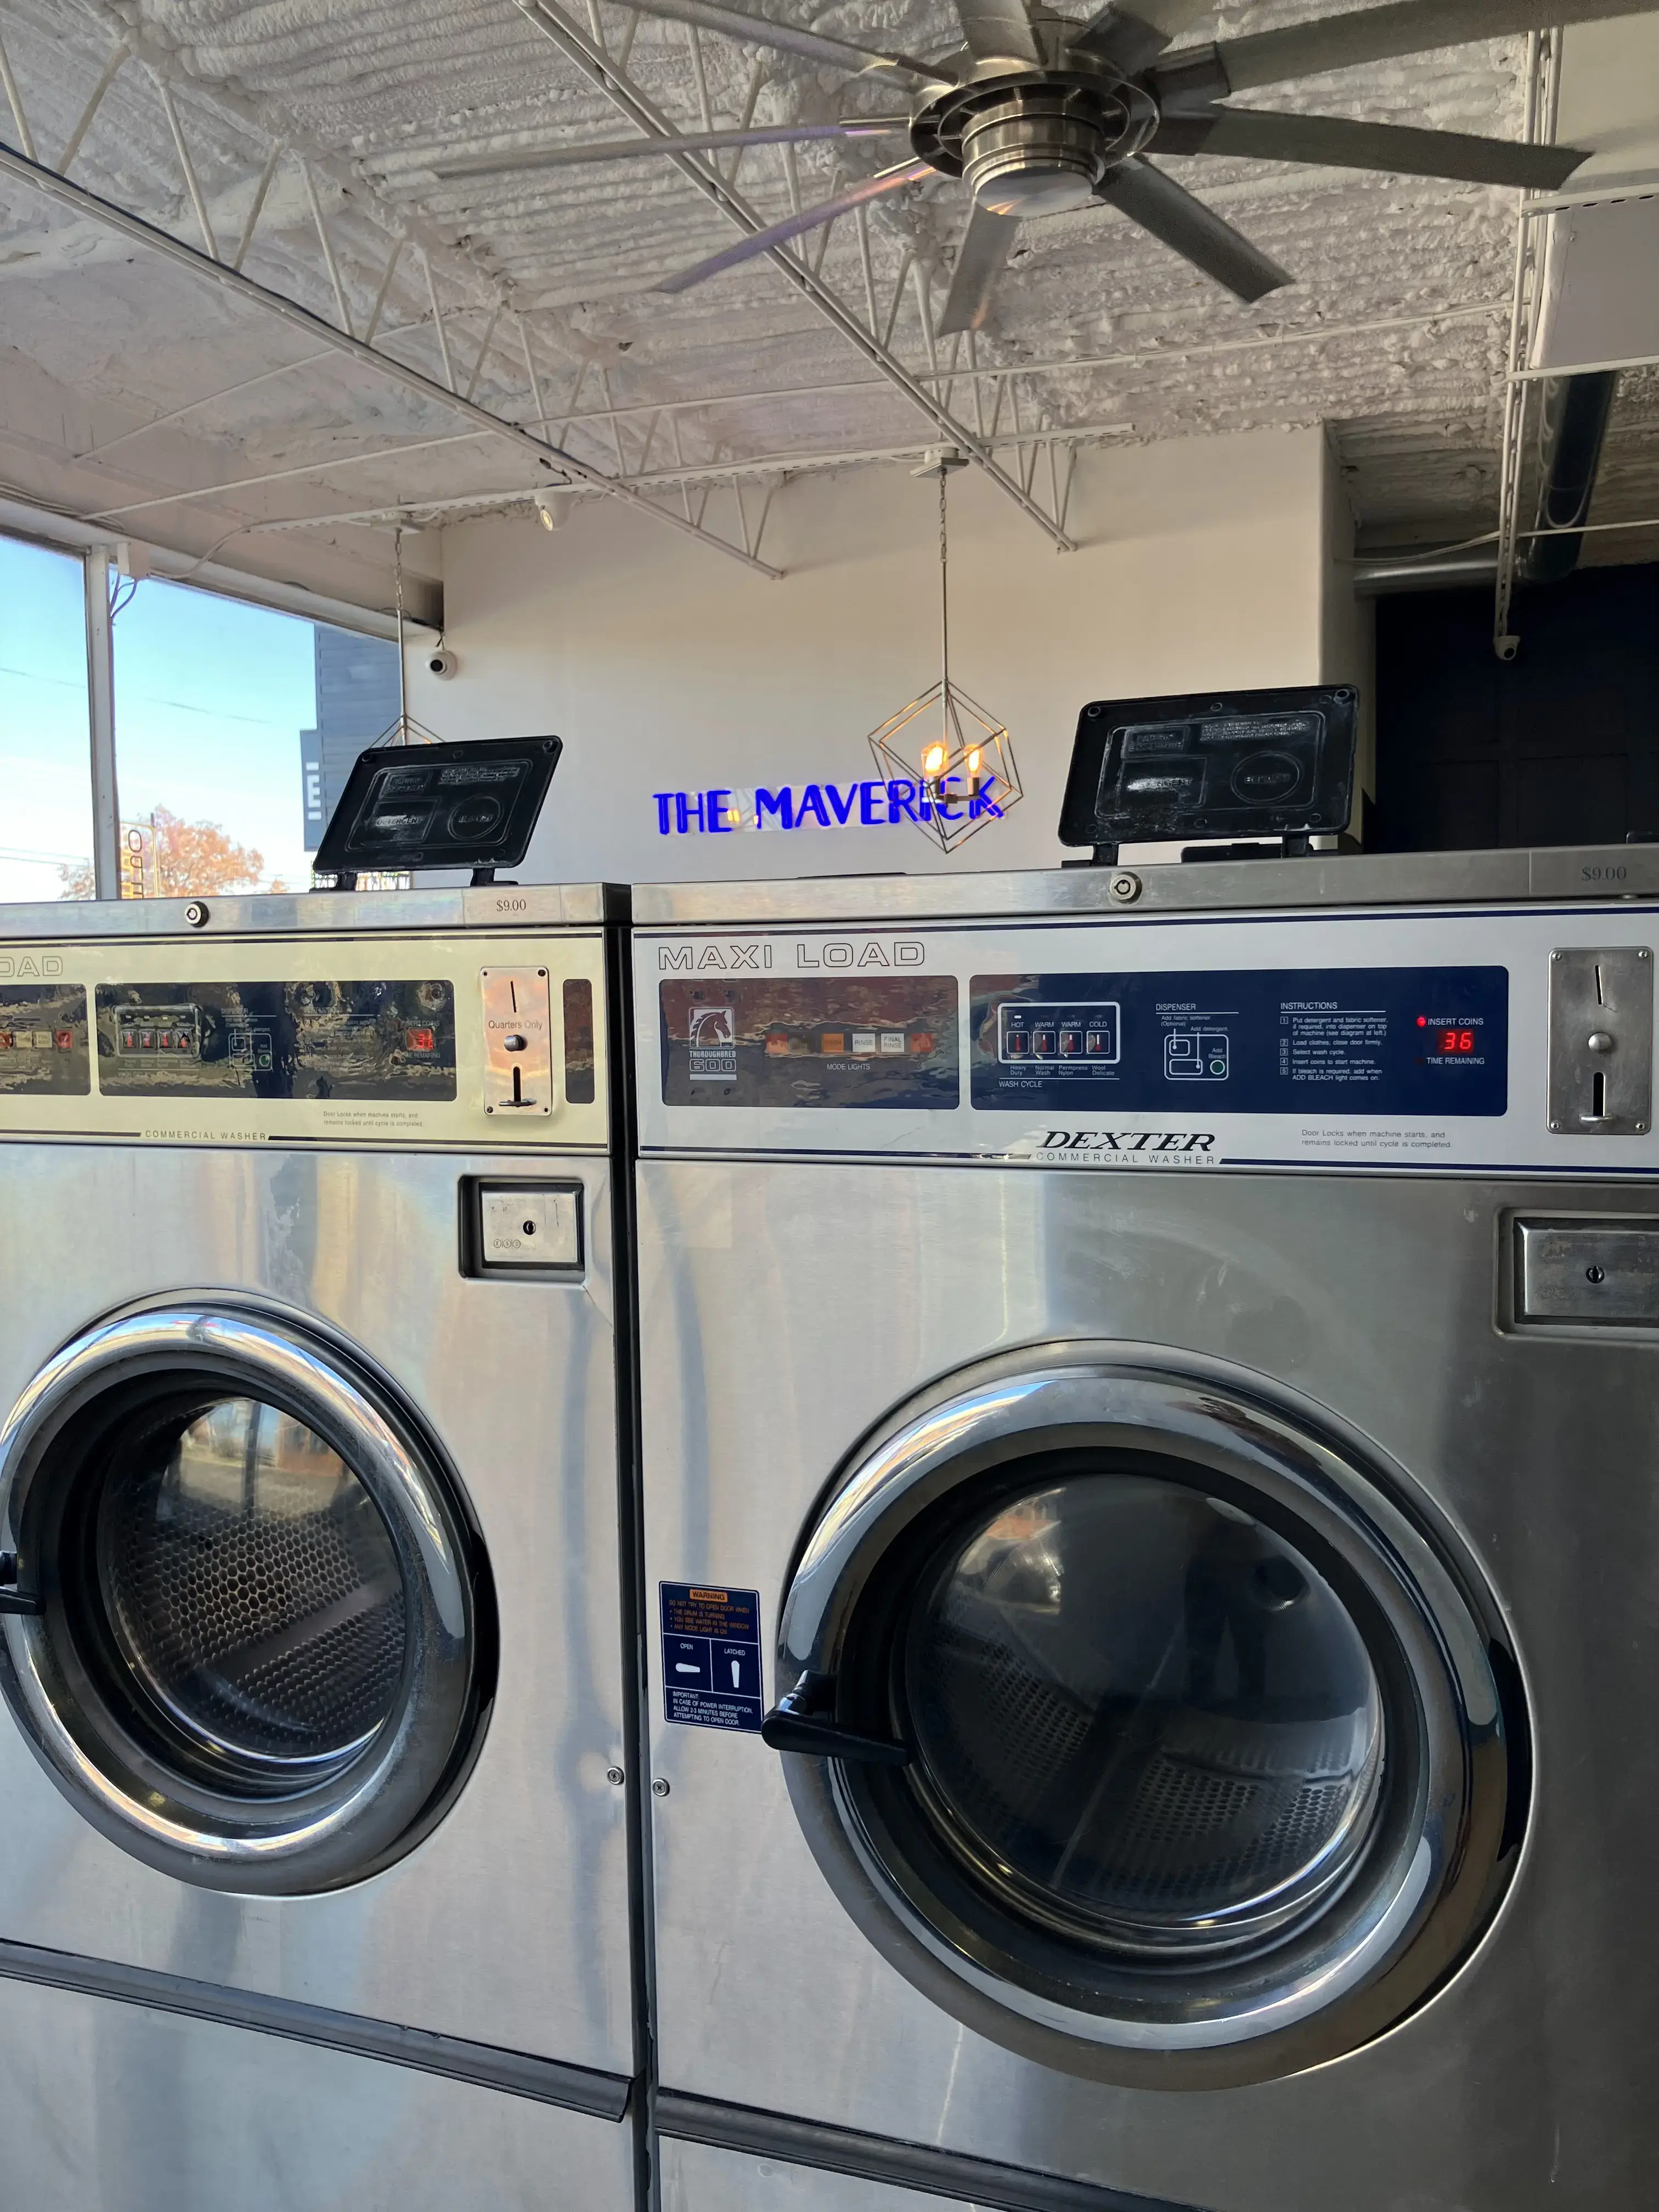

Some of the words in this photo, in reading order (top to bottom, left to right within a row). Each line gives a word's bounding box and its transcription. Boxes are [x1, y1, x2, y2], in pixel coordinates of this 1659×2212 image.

[653, 790, 731, 835] THE
[755, 776, 1003, 830] MAVERICK
[1581, 865, 1627, 882] $9.00
[496, 899, 527, 912] $9.00
[658, 945, 772, 970] MAXI
[797, 941, 925, 968] LOAD
[488, 1020, 522, 1029] Quarters
[524, 1020, 543, 1030] Only
[1444, 1032, 1472, 1049] 36
[690, 1059, 736, 1072] 600
[145, 1130, 215, 1139] COMMERCIAL
[221, 1132, 266, 1140] WASHER
[1035, 1131, 1215, 1152] DEXTER
[1379, 1140, 1399, 1148] cycle
[1036, 1152, 1138, 1163] COMMERCIAL
[1149, 1155, 1215, 1165] WASHER
[692, 1591, 725, 1601] WARNING
[730, 1622, 749, 1630] WINDOW
[724, 1647, 746, 1656] LATCHED
[674, 1712, 702, 1721] ATTEMPTING
[698, 1708, 718, 1716] MINUTES
[719, 1711, 738, 1719] BEFORE
